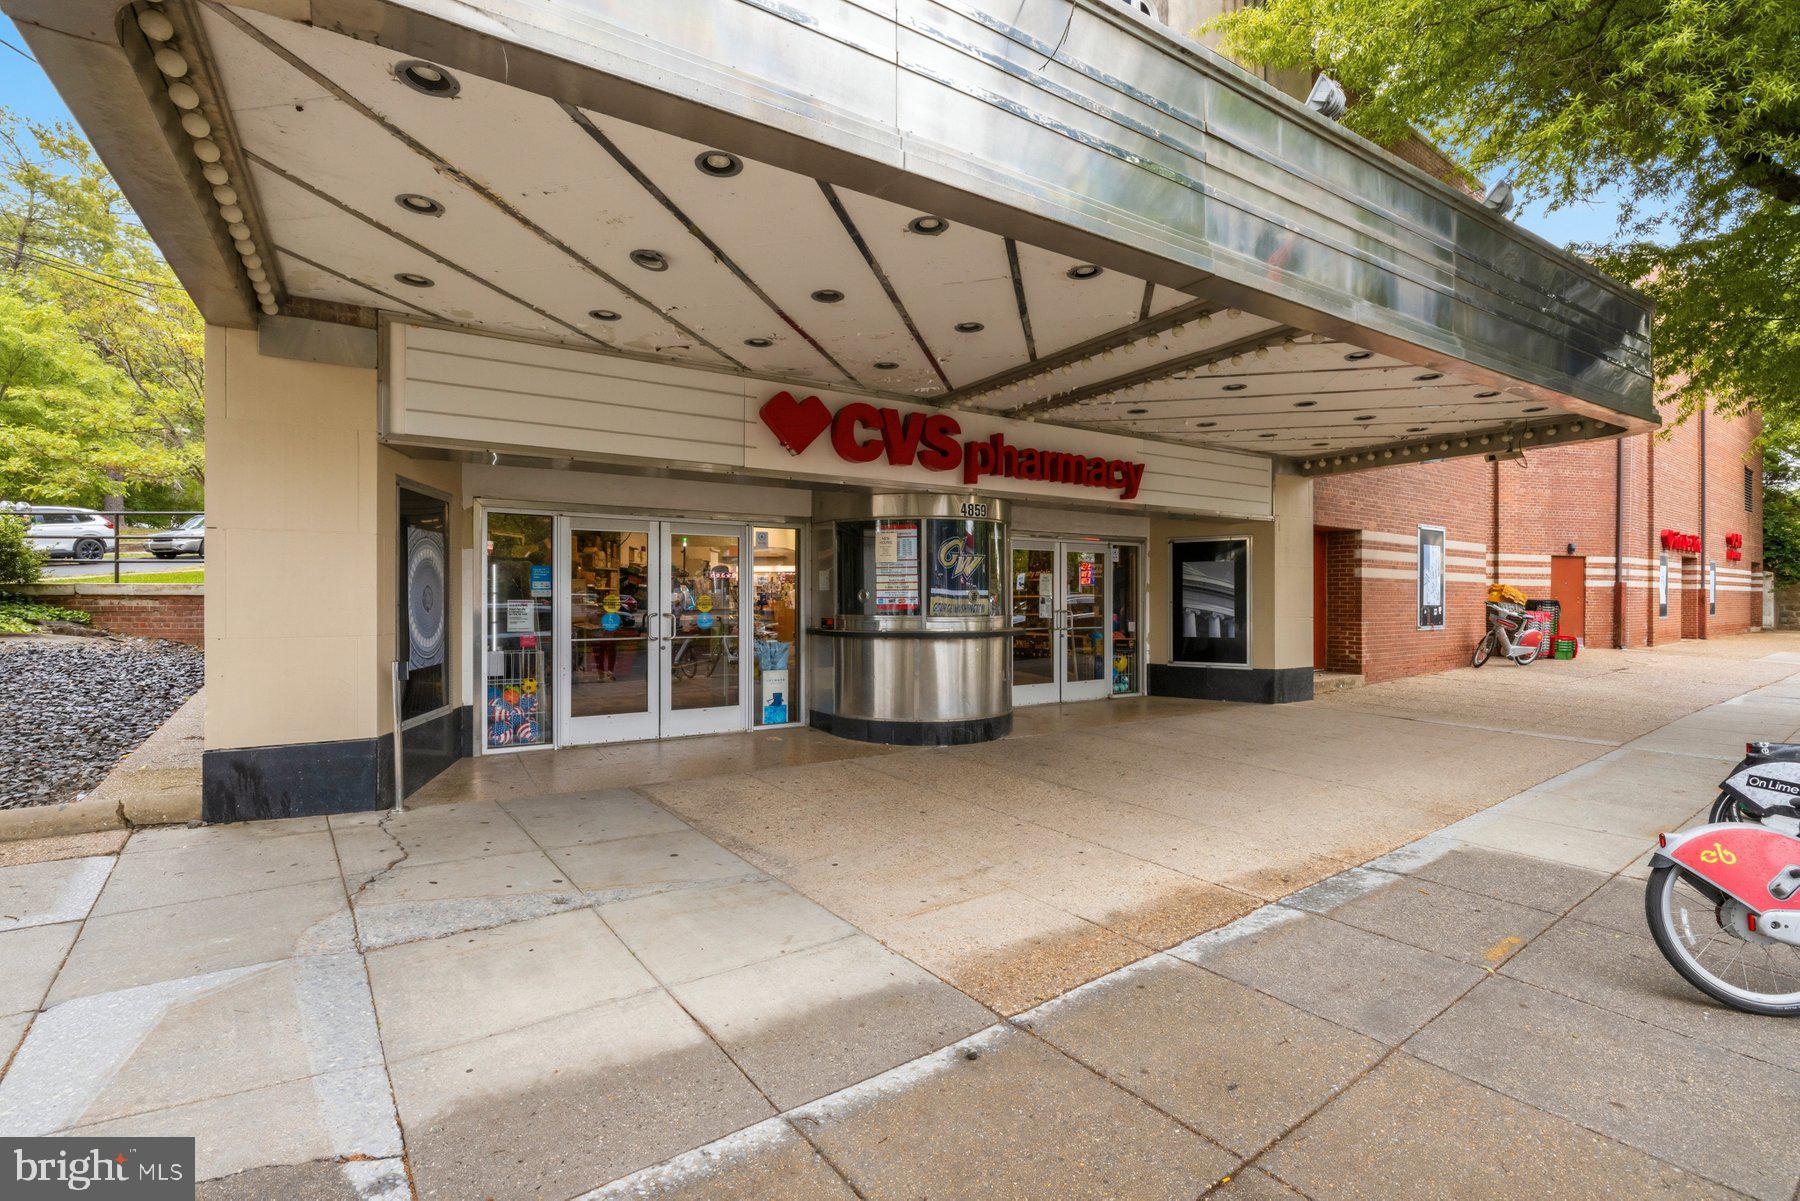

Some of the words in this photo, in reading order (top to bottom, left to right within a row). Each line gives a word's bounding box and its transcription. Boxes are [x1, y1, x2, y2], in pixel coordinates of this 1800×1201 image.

[831, 402, 963, 471] CVS
[963, 432, 1145, 500] pharmacy
[960, 503, 988, 518] 4859
[938, 536, 987, 580] GW
[1749, 777, 1767, 788] On
[1768, 780, 1799, 794] Lime
